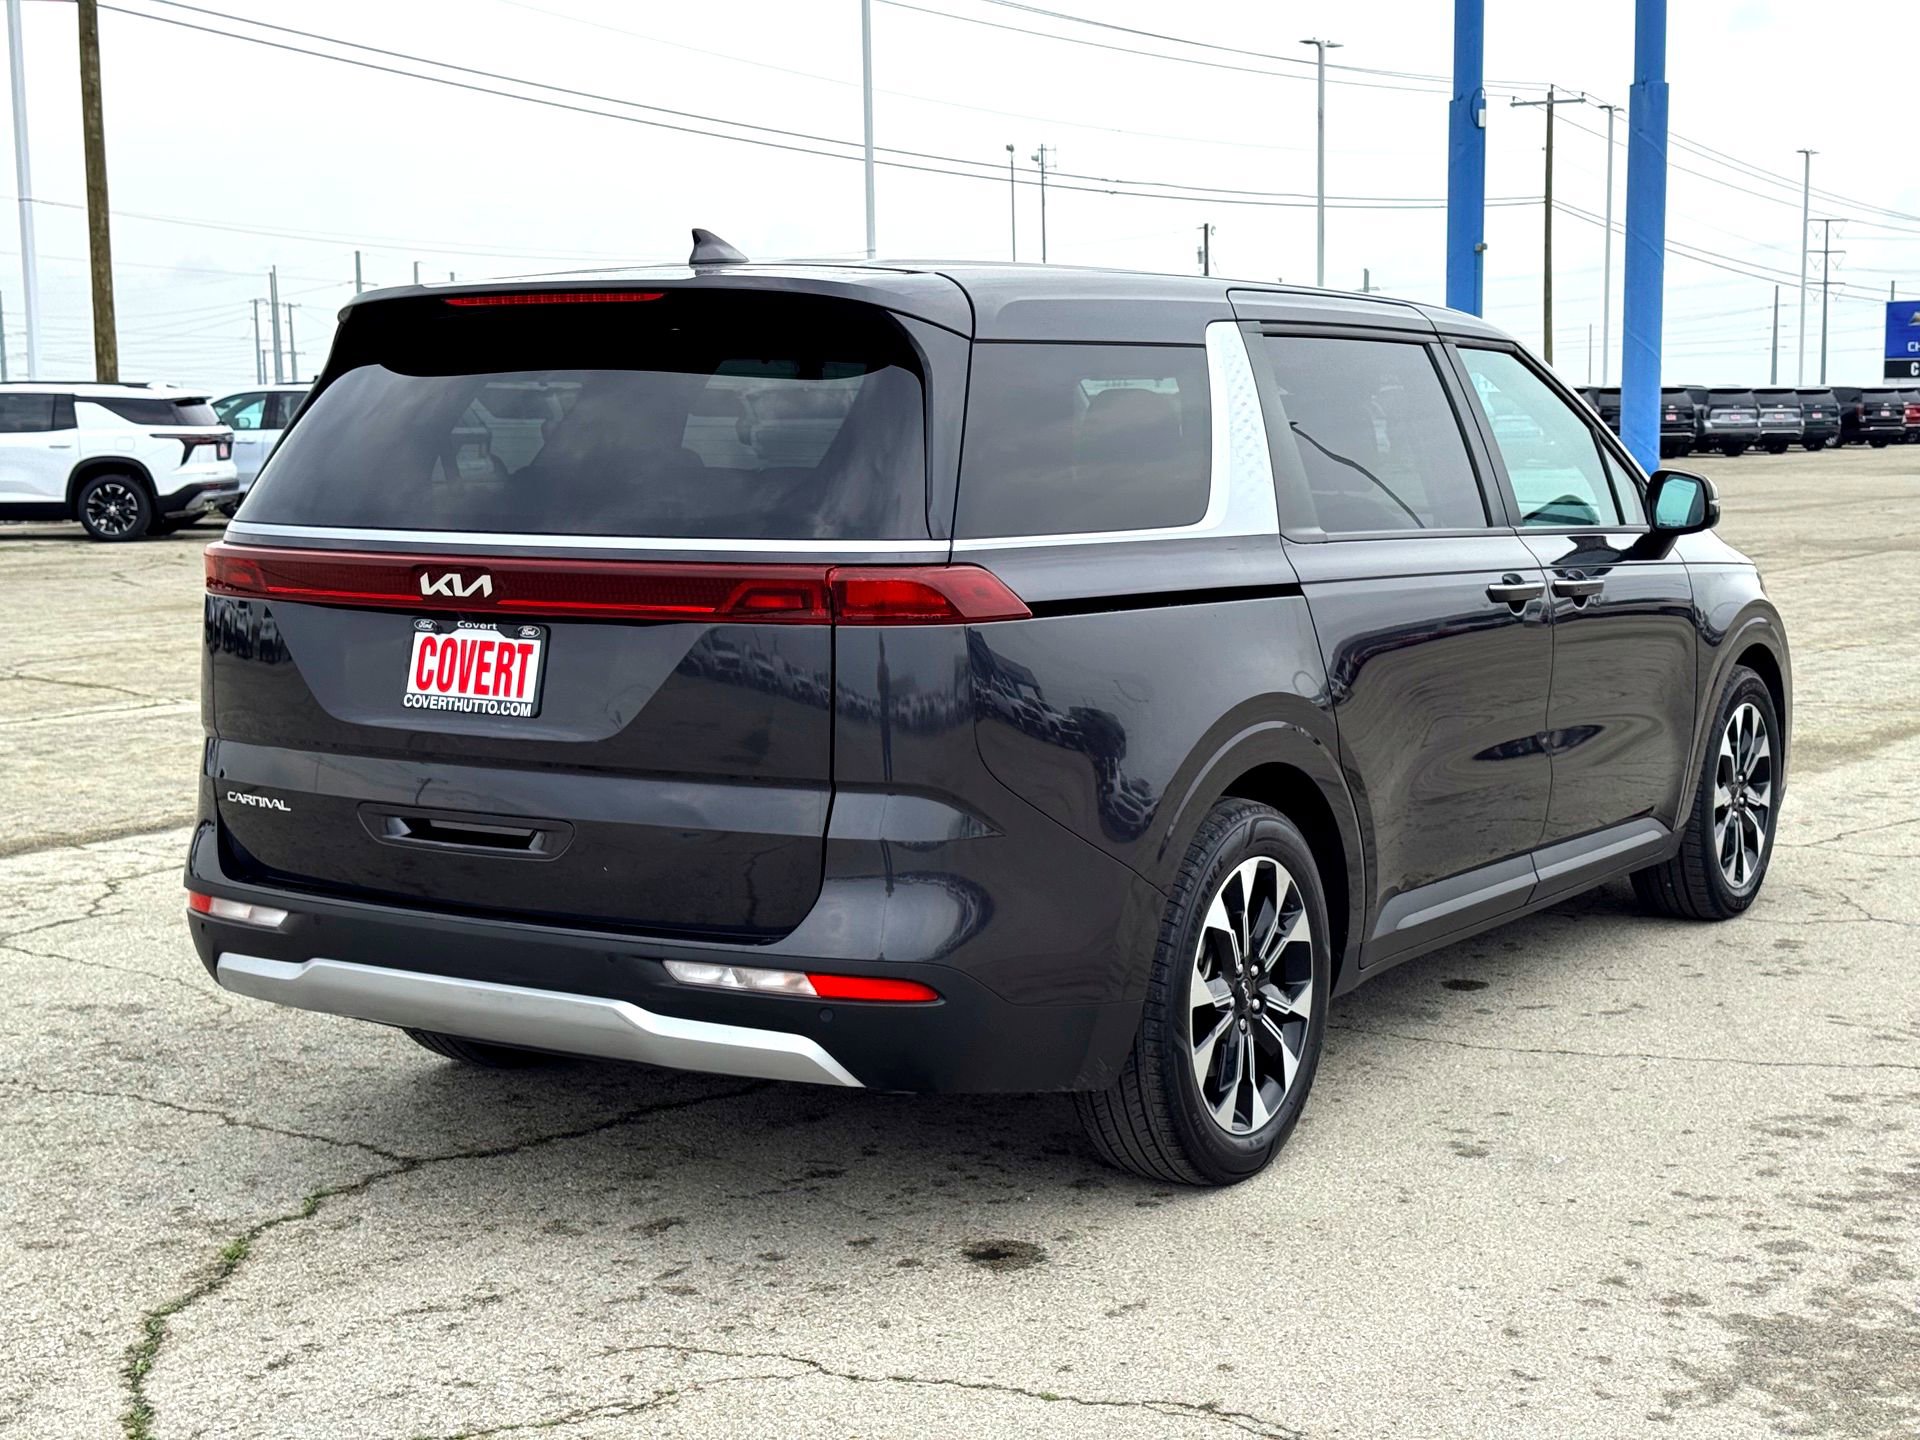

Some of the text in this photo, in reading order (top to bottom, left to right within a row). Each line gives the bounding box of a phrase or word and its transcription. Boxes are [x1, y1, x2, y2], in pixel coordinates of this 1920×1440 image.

[420, 572, 493, 598] KIA
[457, 620, 498, 630] Covert
[415, 636, 534, 698] COVERT
[403, 694, 532, 717] COVERTHUTTO.COM
[227, 791, 292, 812] CARNIVAL
